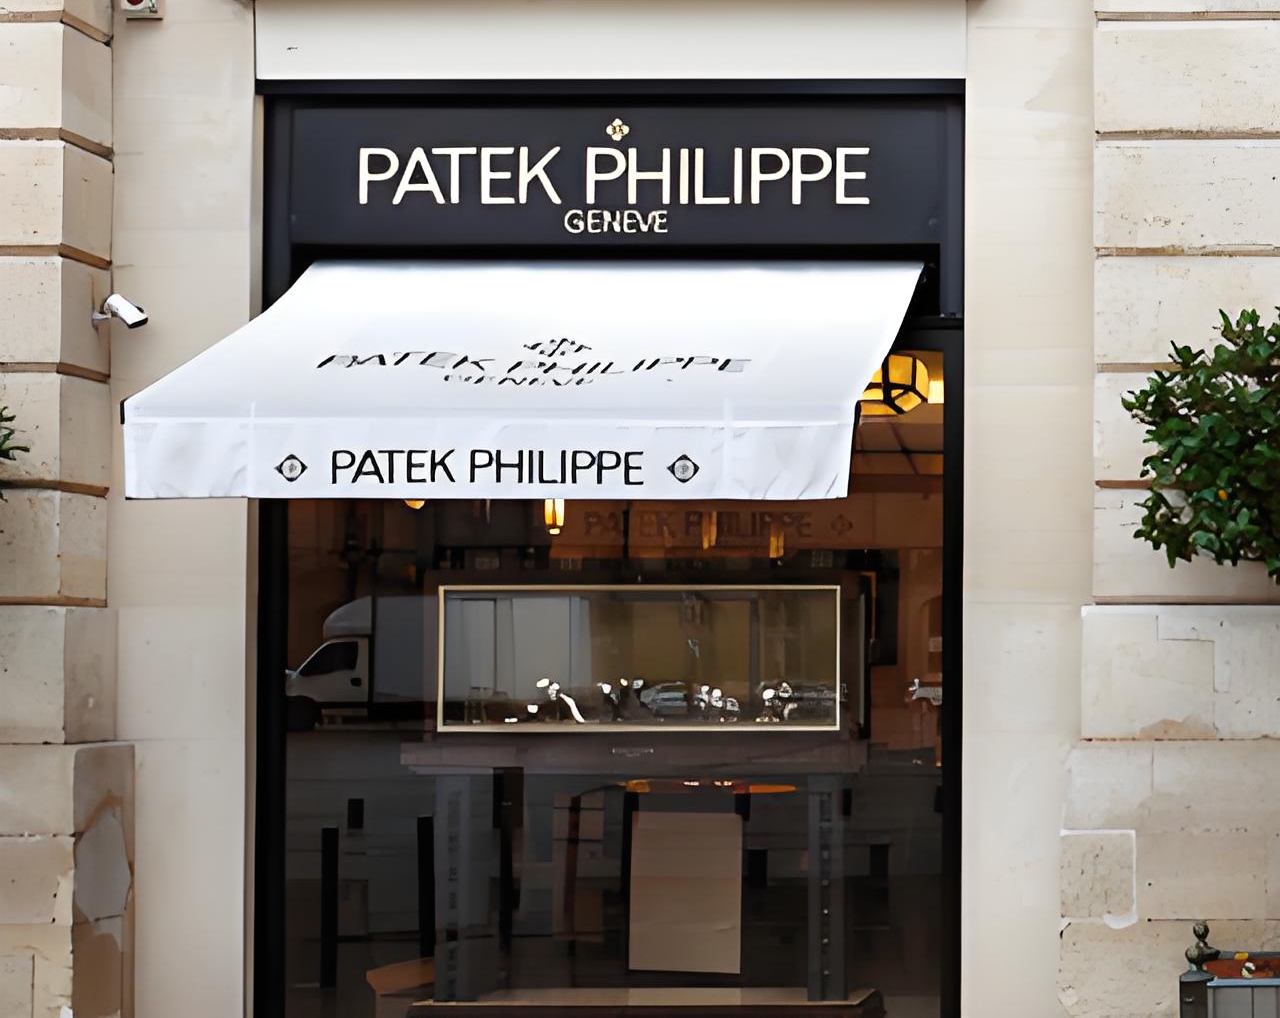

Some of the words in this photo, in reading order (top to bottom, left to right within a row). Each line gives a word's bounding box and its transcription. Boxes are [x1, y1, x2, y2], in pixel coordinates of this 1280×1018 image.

[359, 146, 561, 204] PATEK
[586, 147, 870, 204] PHILIPPE
[332, 449, 455, 484] PATEK
[470, 450, 644, 485] PHILIPPE
